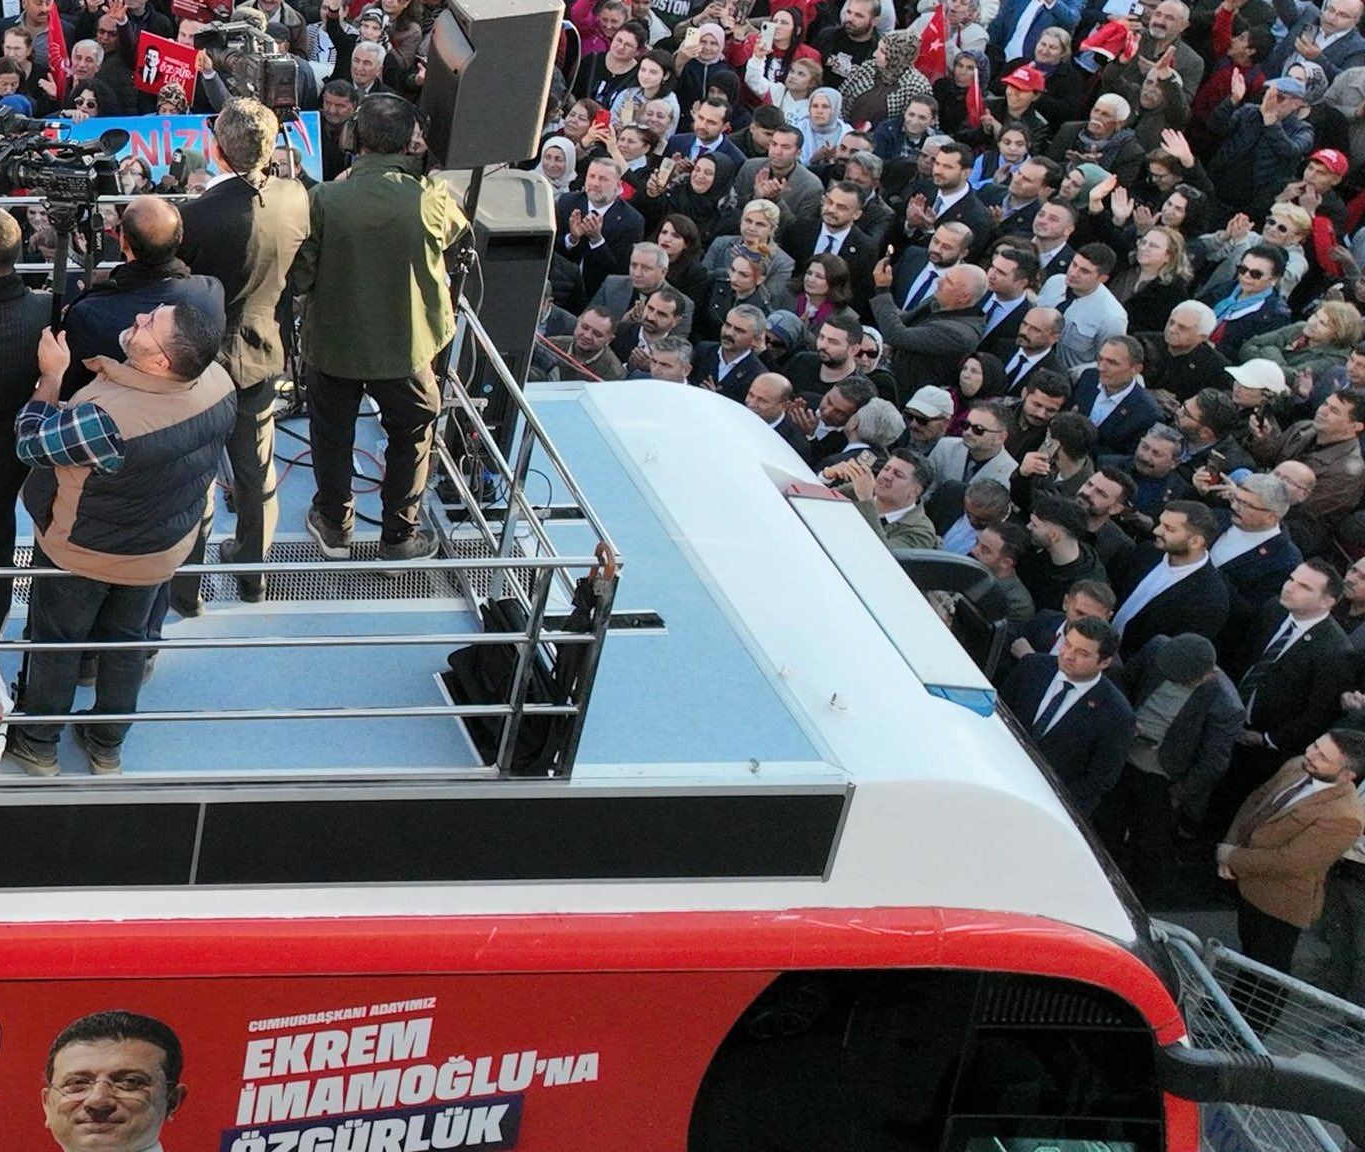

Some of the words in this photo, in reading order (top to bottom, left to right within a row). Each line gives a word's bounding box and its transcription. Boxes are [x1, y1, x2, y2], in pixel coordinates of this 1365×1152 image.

[248, 1006, 368, 1033] CUMHURBAŞKANI
[369, 996, 437, 1018] ADAYIMIZ
[242, 1017, 434, 1081] EKREM
[235, 1051, 600, 1126] İMAMOĞLU'NA
